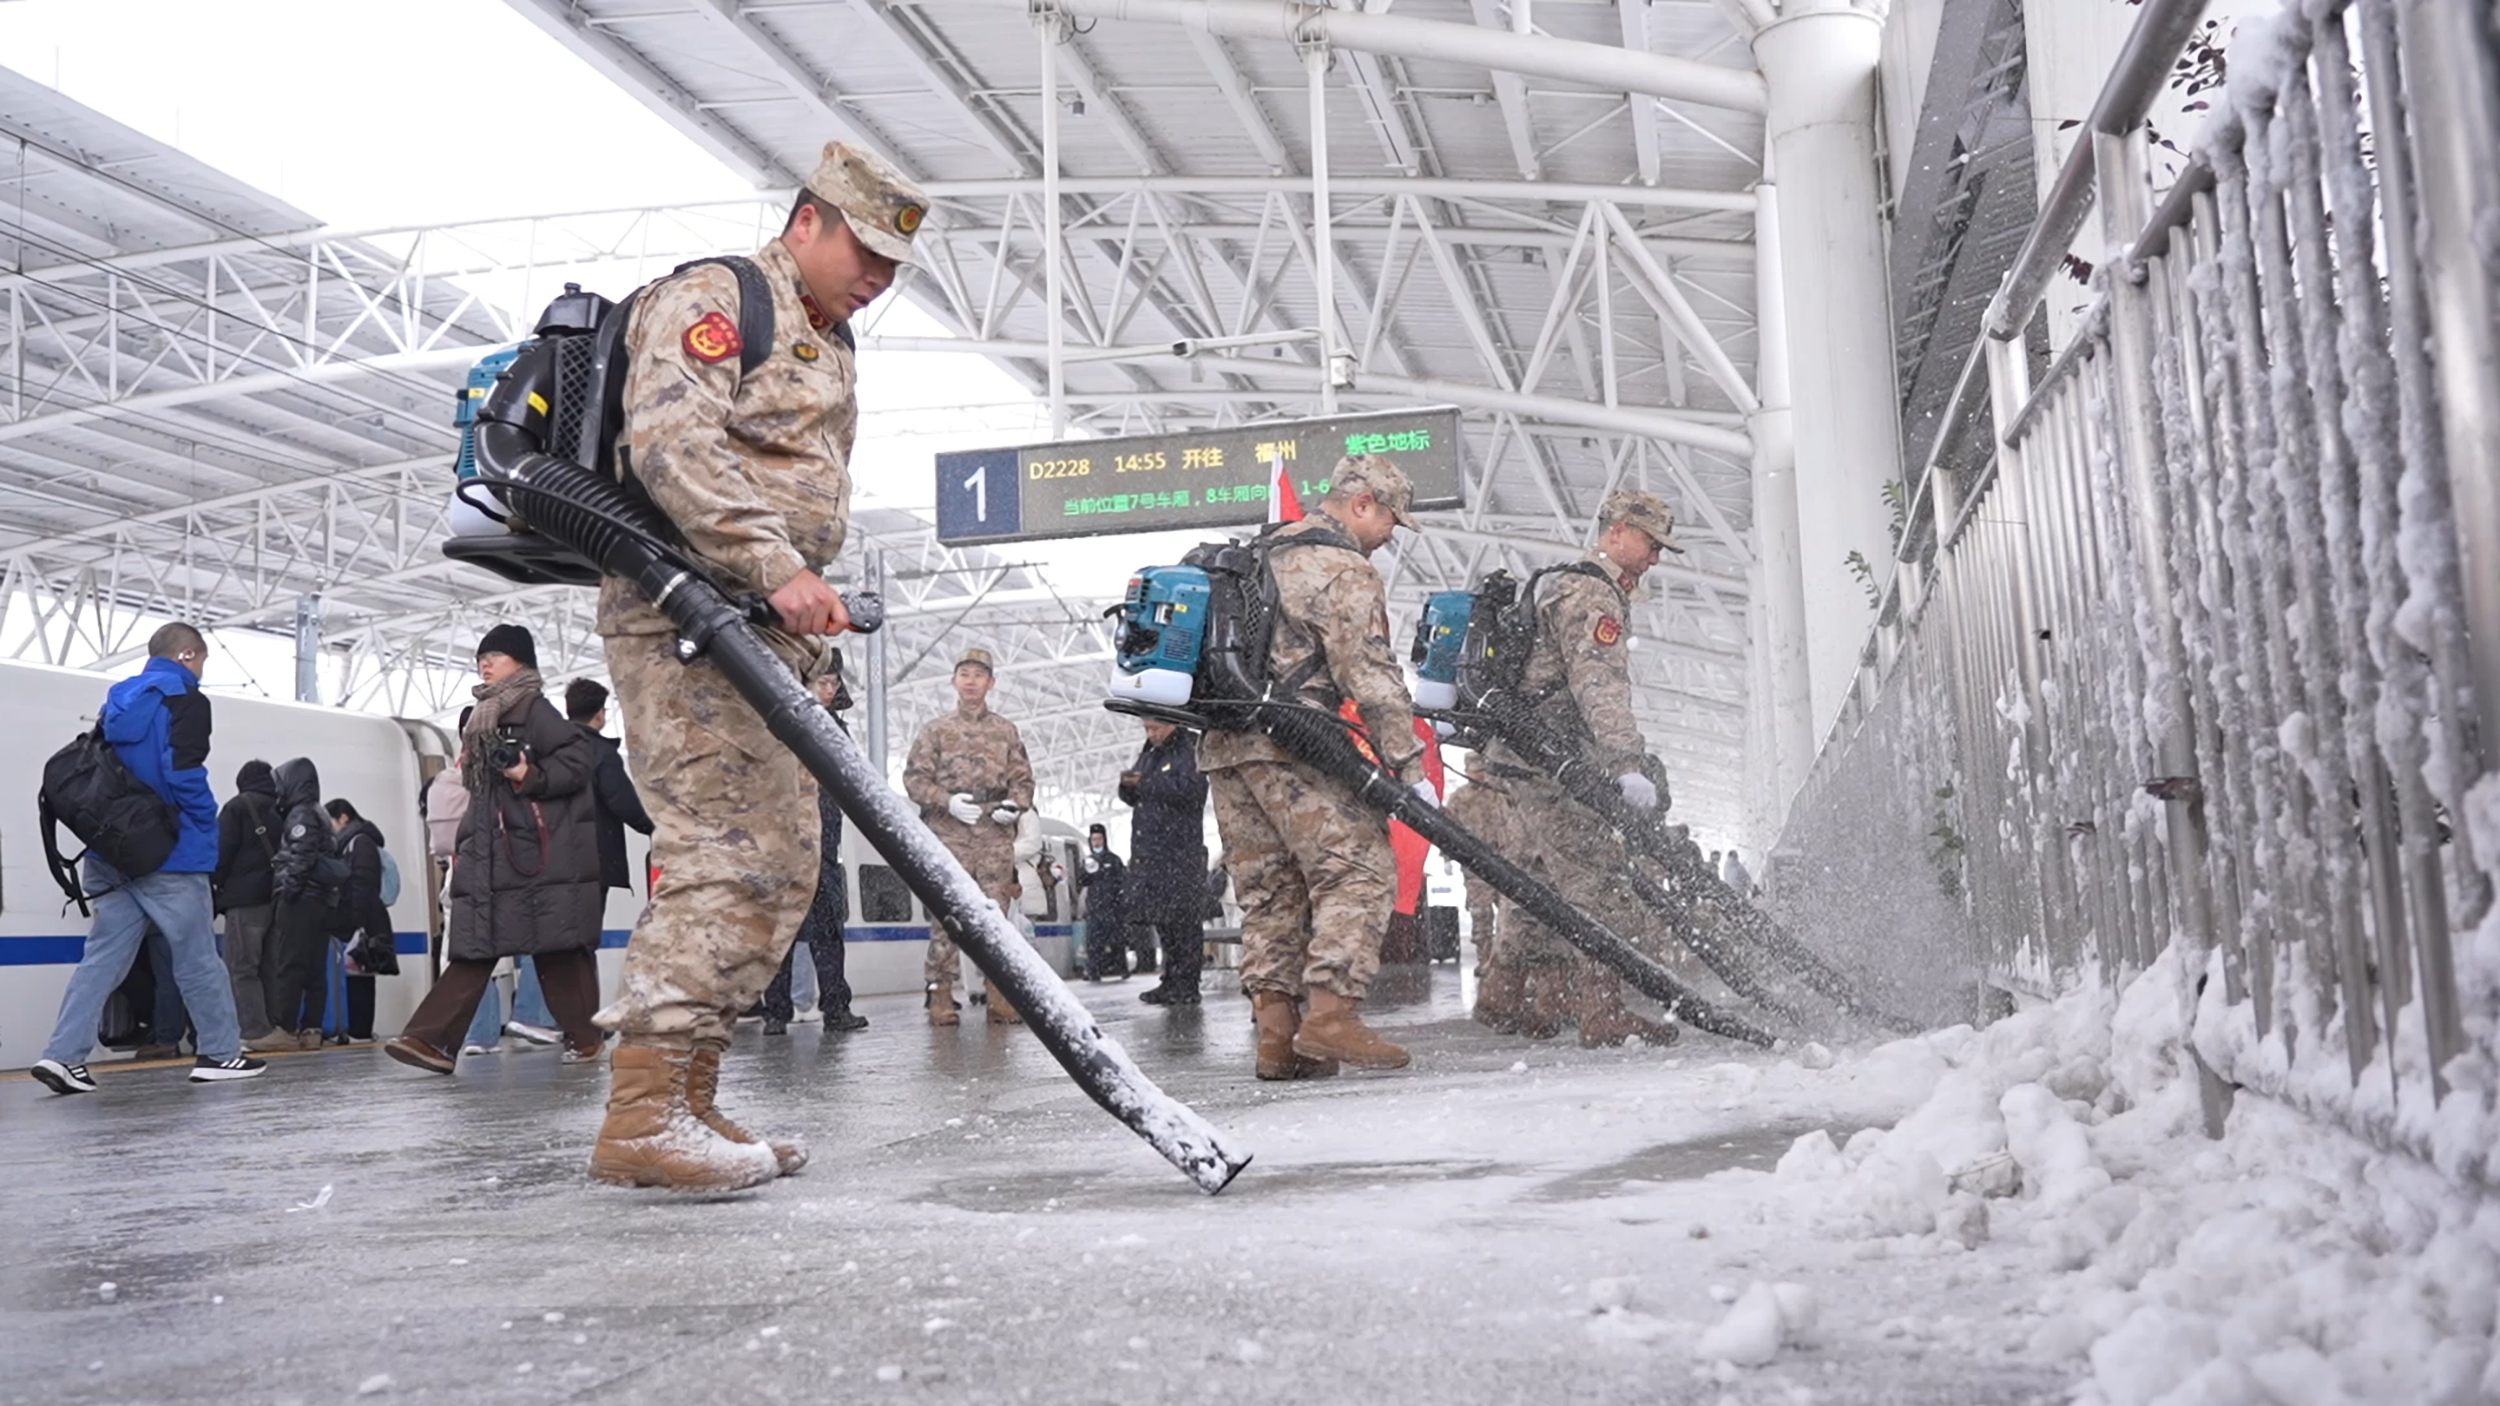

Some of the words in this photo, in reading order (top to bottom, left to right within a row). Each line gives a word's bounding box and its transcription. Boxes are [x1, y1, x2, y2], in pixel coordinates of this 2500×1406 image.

[1030, 459, 1090, 479] D2228
[1114, 452, 1166, 473] 14:55
[1182, 447, 1224, 469] 开往
[1255, 440, 1296, 463] 福州
[1345, 430, 1430, 455] 紫色地标
[964, 466, 986, 522] 1
